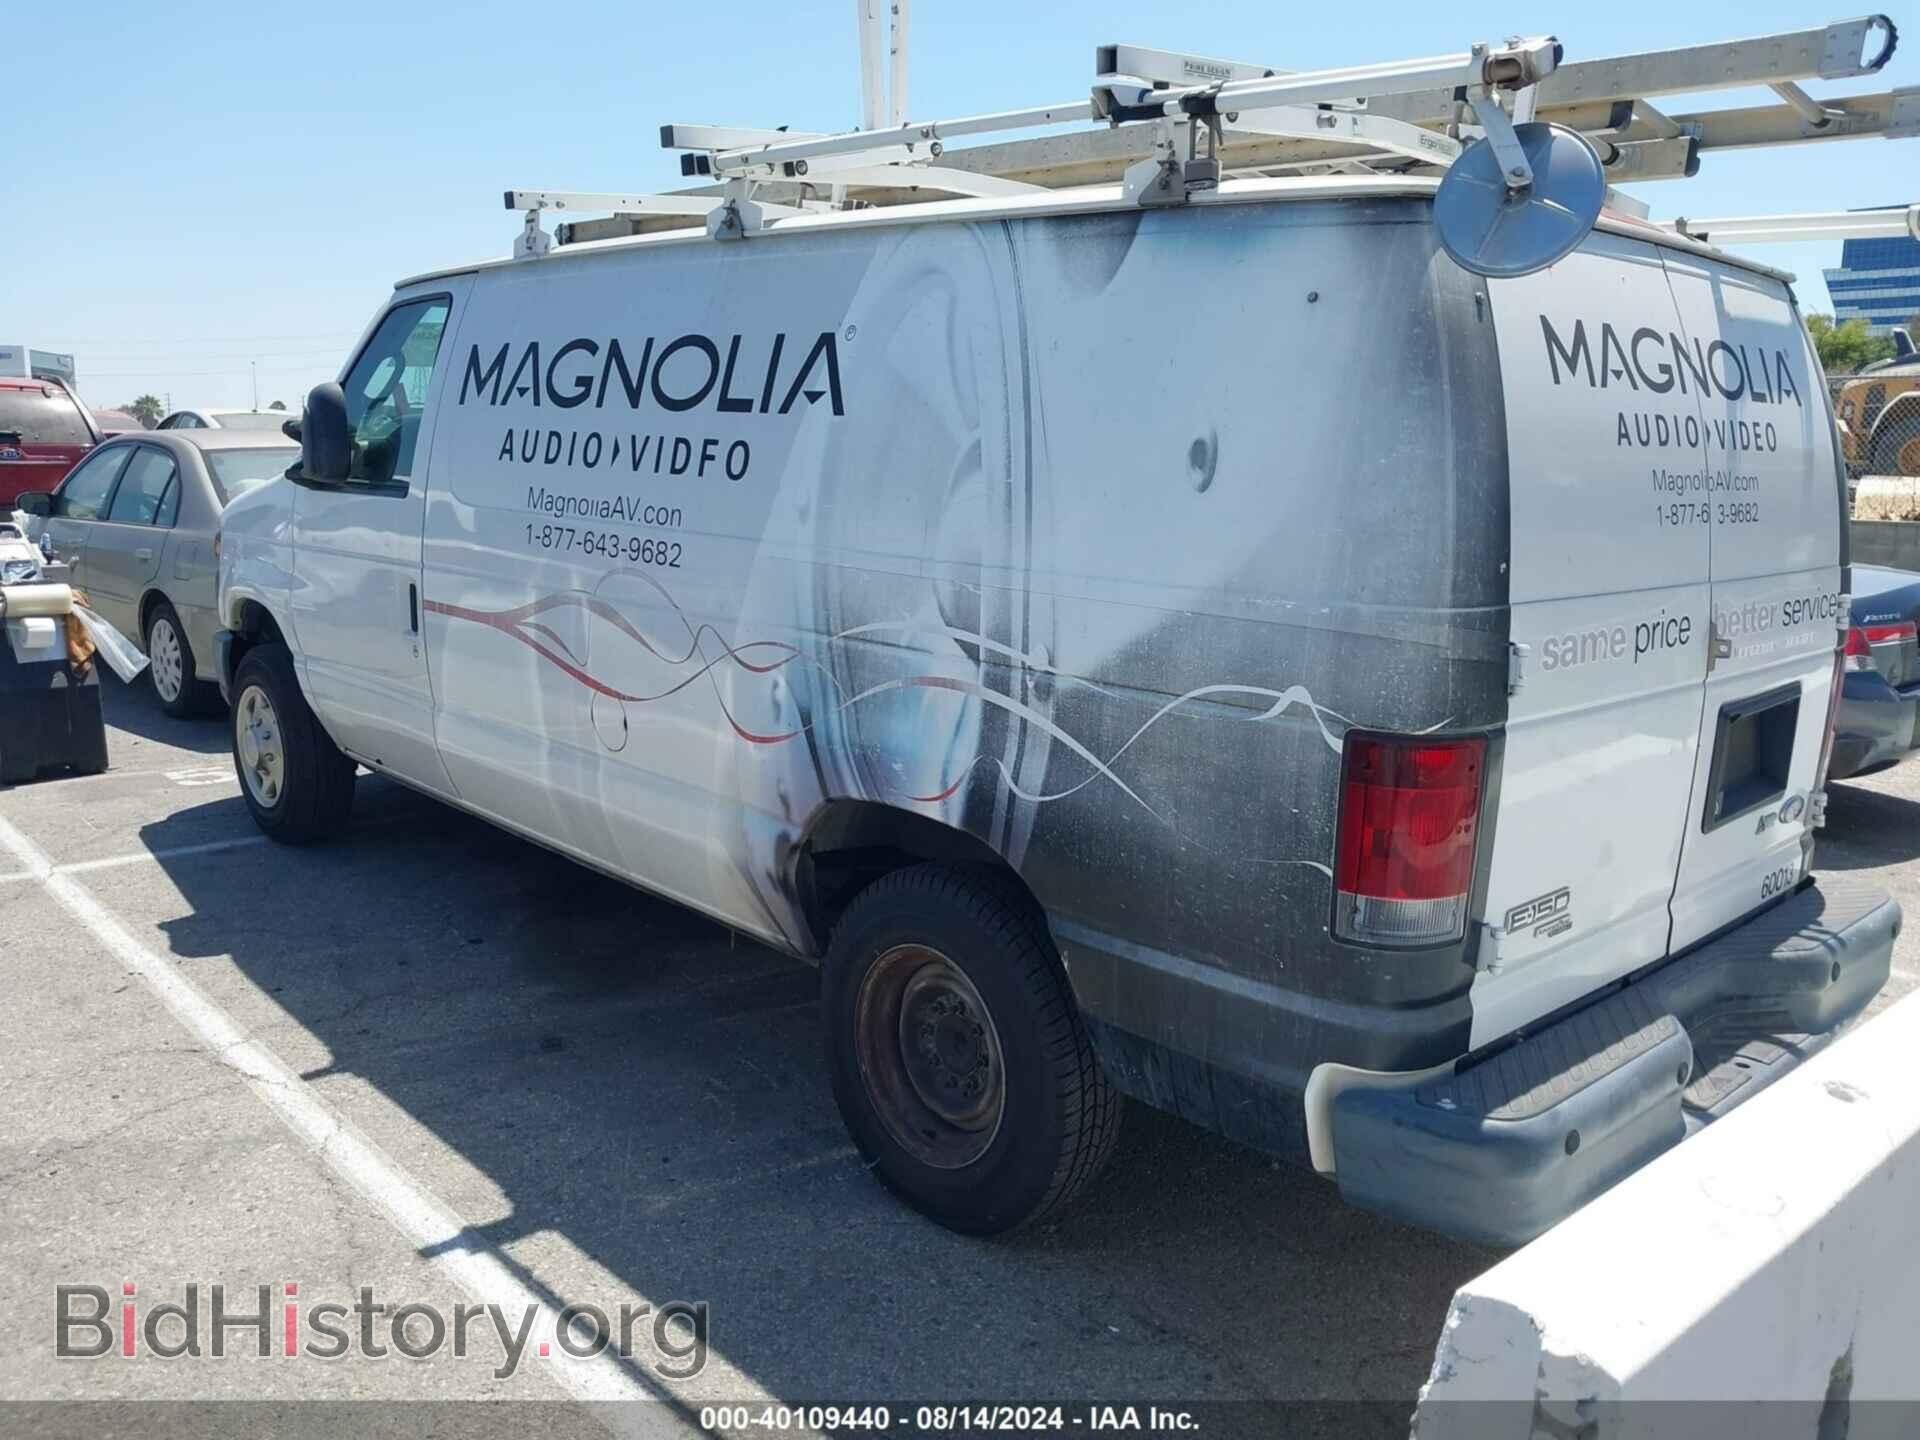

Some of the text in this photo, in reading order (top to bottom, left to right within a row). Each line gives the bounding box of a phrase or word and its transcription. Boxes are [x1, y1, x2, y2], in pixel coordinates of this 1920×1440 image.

[459, 332, 845, 416] MAGNOLIA
[1539, 314, 1802, 407] MAGNOLIA
[498, 428, 601, 468] AUDIO
[1616, 412, 1777, 452] AUDIO VIDEO
[1657, 502, 1759, 526] 1-877-63-9682
[526, 523, 682, 568] 1-877-643-9682
[1542, 626, 1626, 671] same
[1634, 609, 1691, 664] price
[1713, 600, 1777, 637] better
[1782, 588, 1838, 626] service
